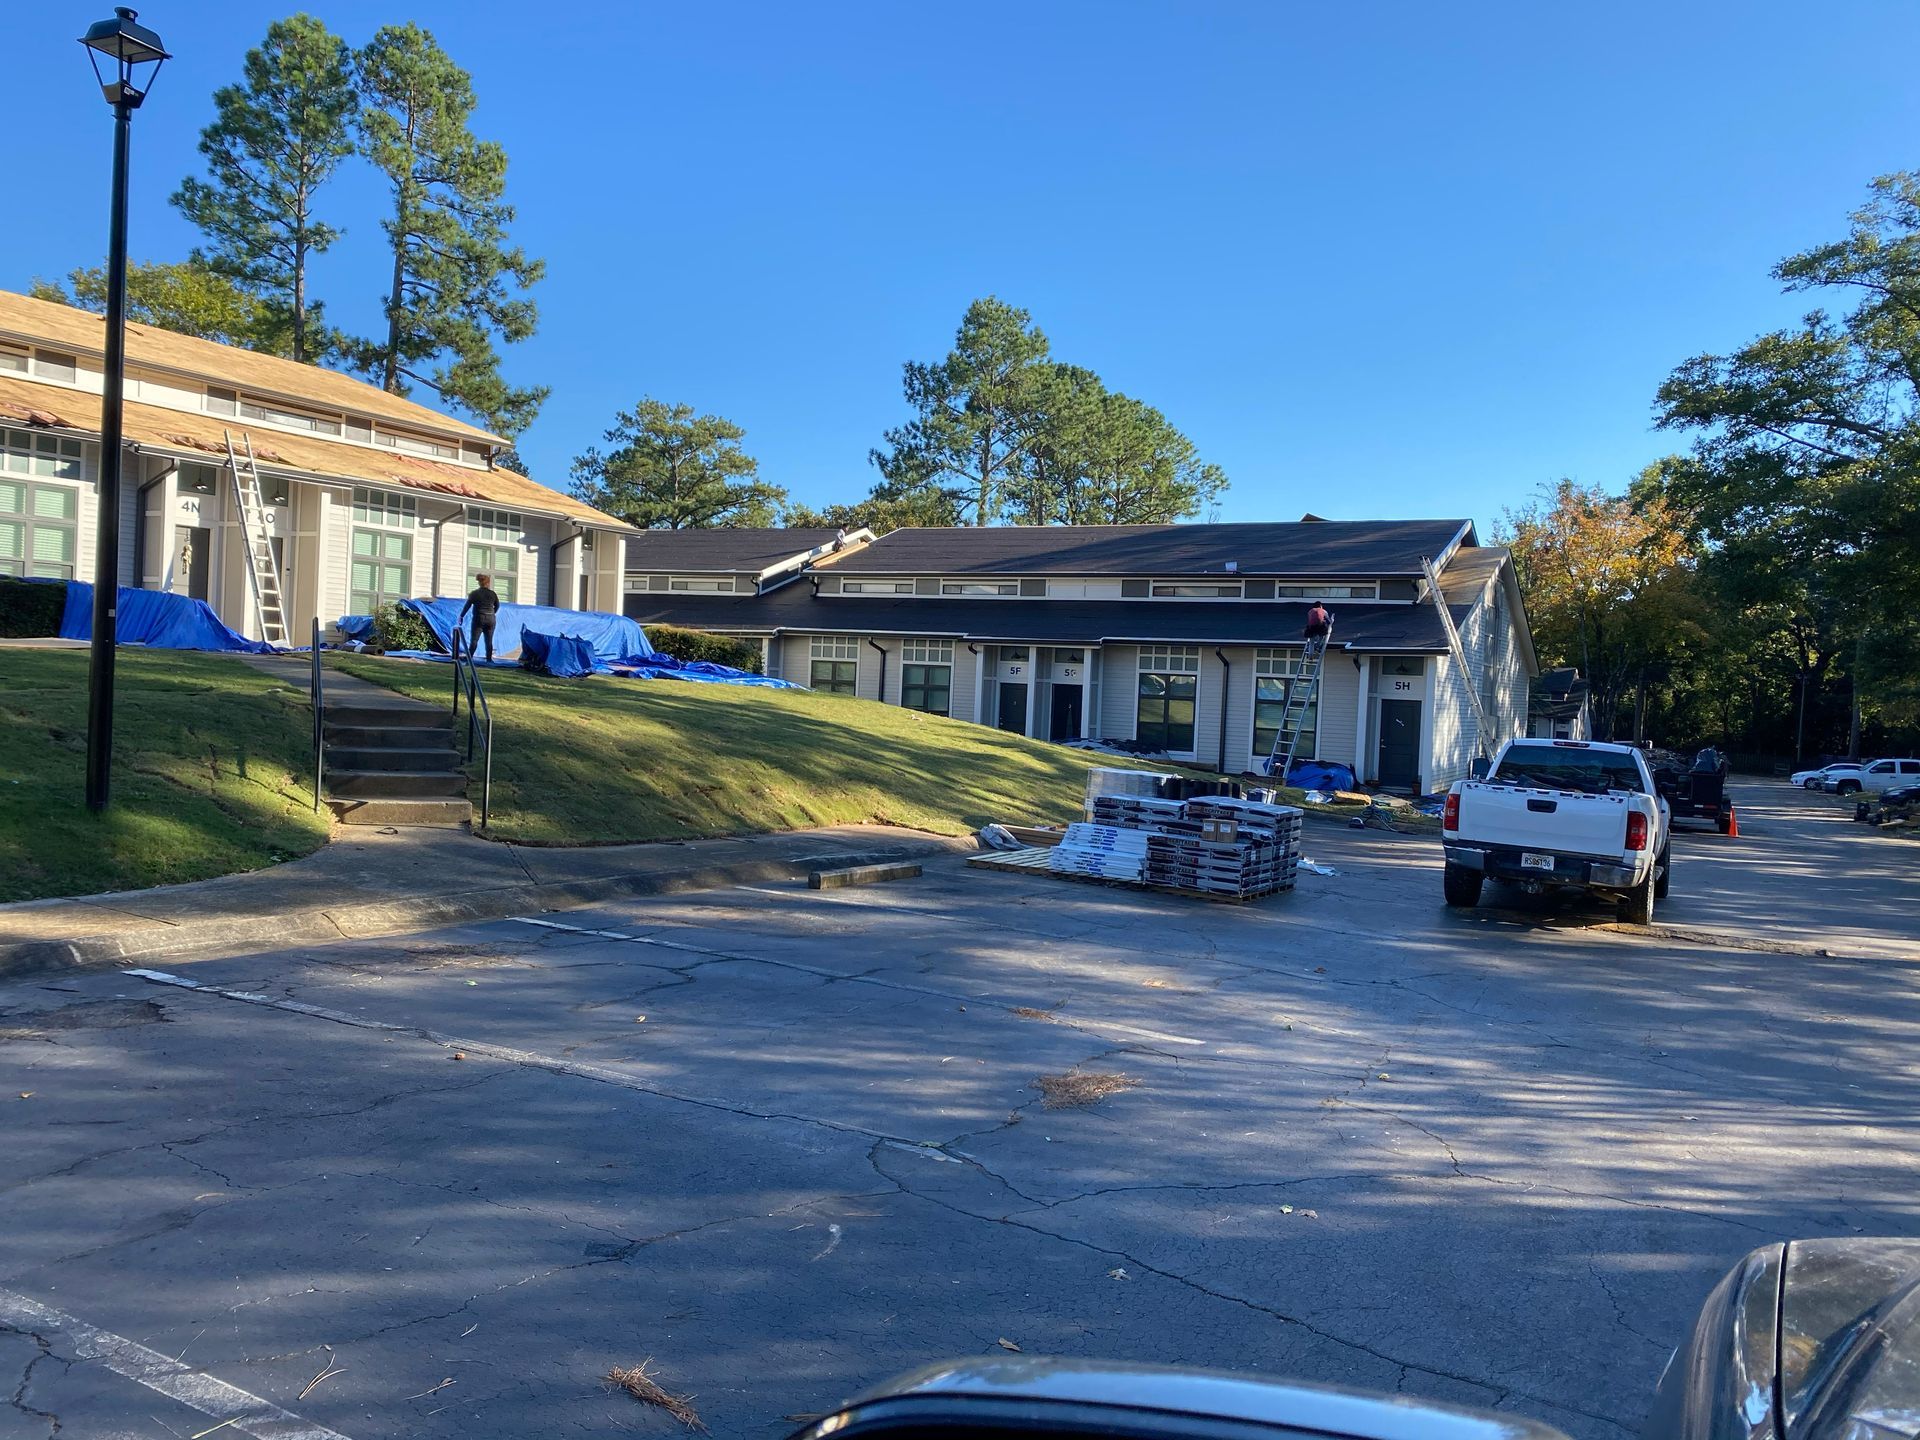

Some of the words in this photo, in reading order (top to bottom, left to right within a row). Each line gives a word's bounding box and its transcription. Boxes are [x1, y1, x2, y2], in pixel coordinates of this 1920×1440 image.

[181, 500, 200, 513] 4N
[1010, 667, 1021, 675] 5F
[1395, 681, 1410, 690] 5H
